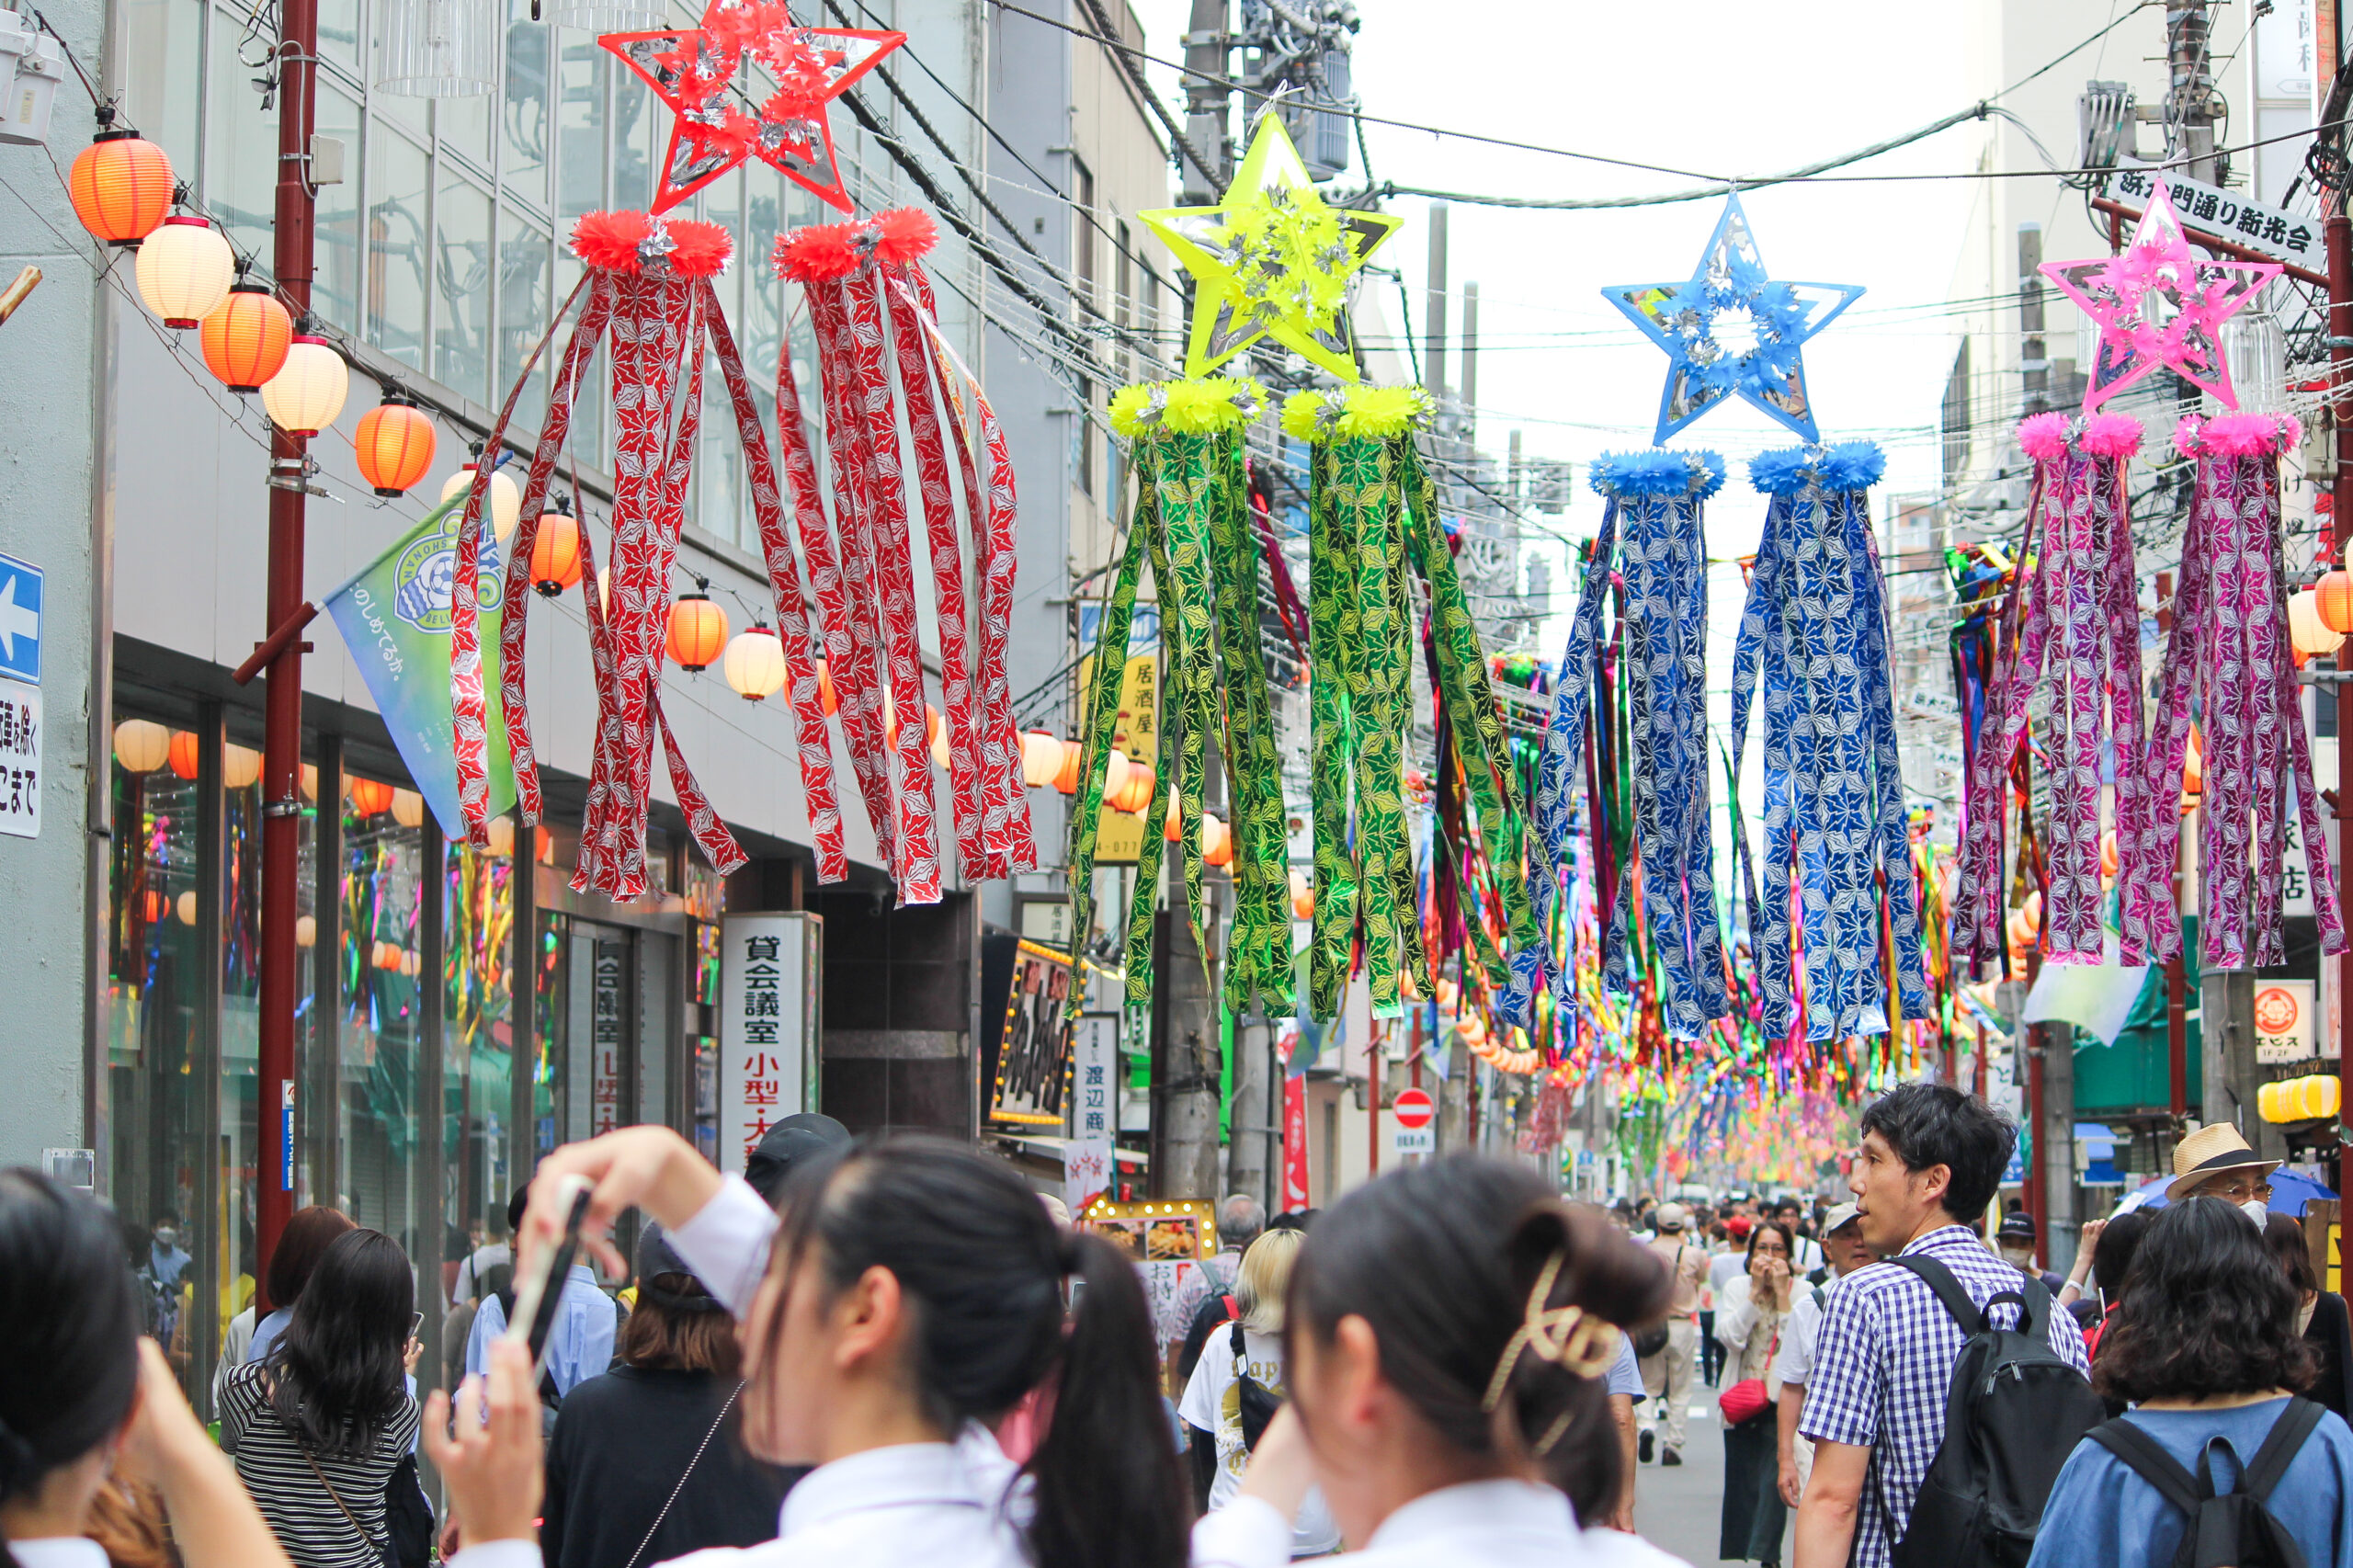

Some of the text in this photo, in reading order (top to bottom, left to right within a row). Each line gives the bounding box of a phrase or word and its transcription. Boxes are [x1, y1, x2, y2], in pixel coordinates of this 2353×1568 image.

[2120, 170, 2313, 255] 浜門通り新光会
[404, 539, 448, 579] SHONAN
[348, 581, 404, 682] のしめてるか。
[0, 699, 37, 758] 車を除く
[1135, 663, 1154, 734] 居酒屋
[744, 936, 780, 1171] 貸会議室 小型・大
[1086, 1065, 1106, 1139] 渡辺商
